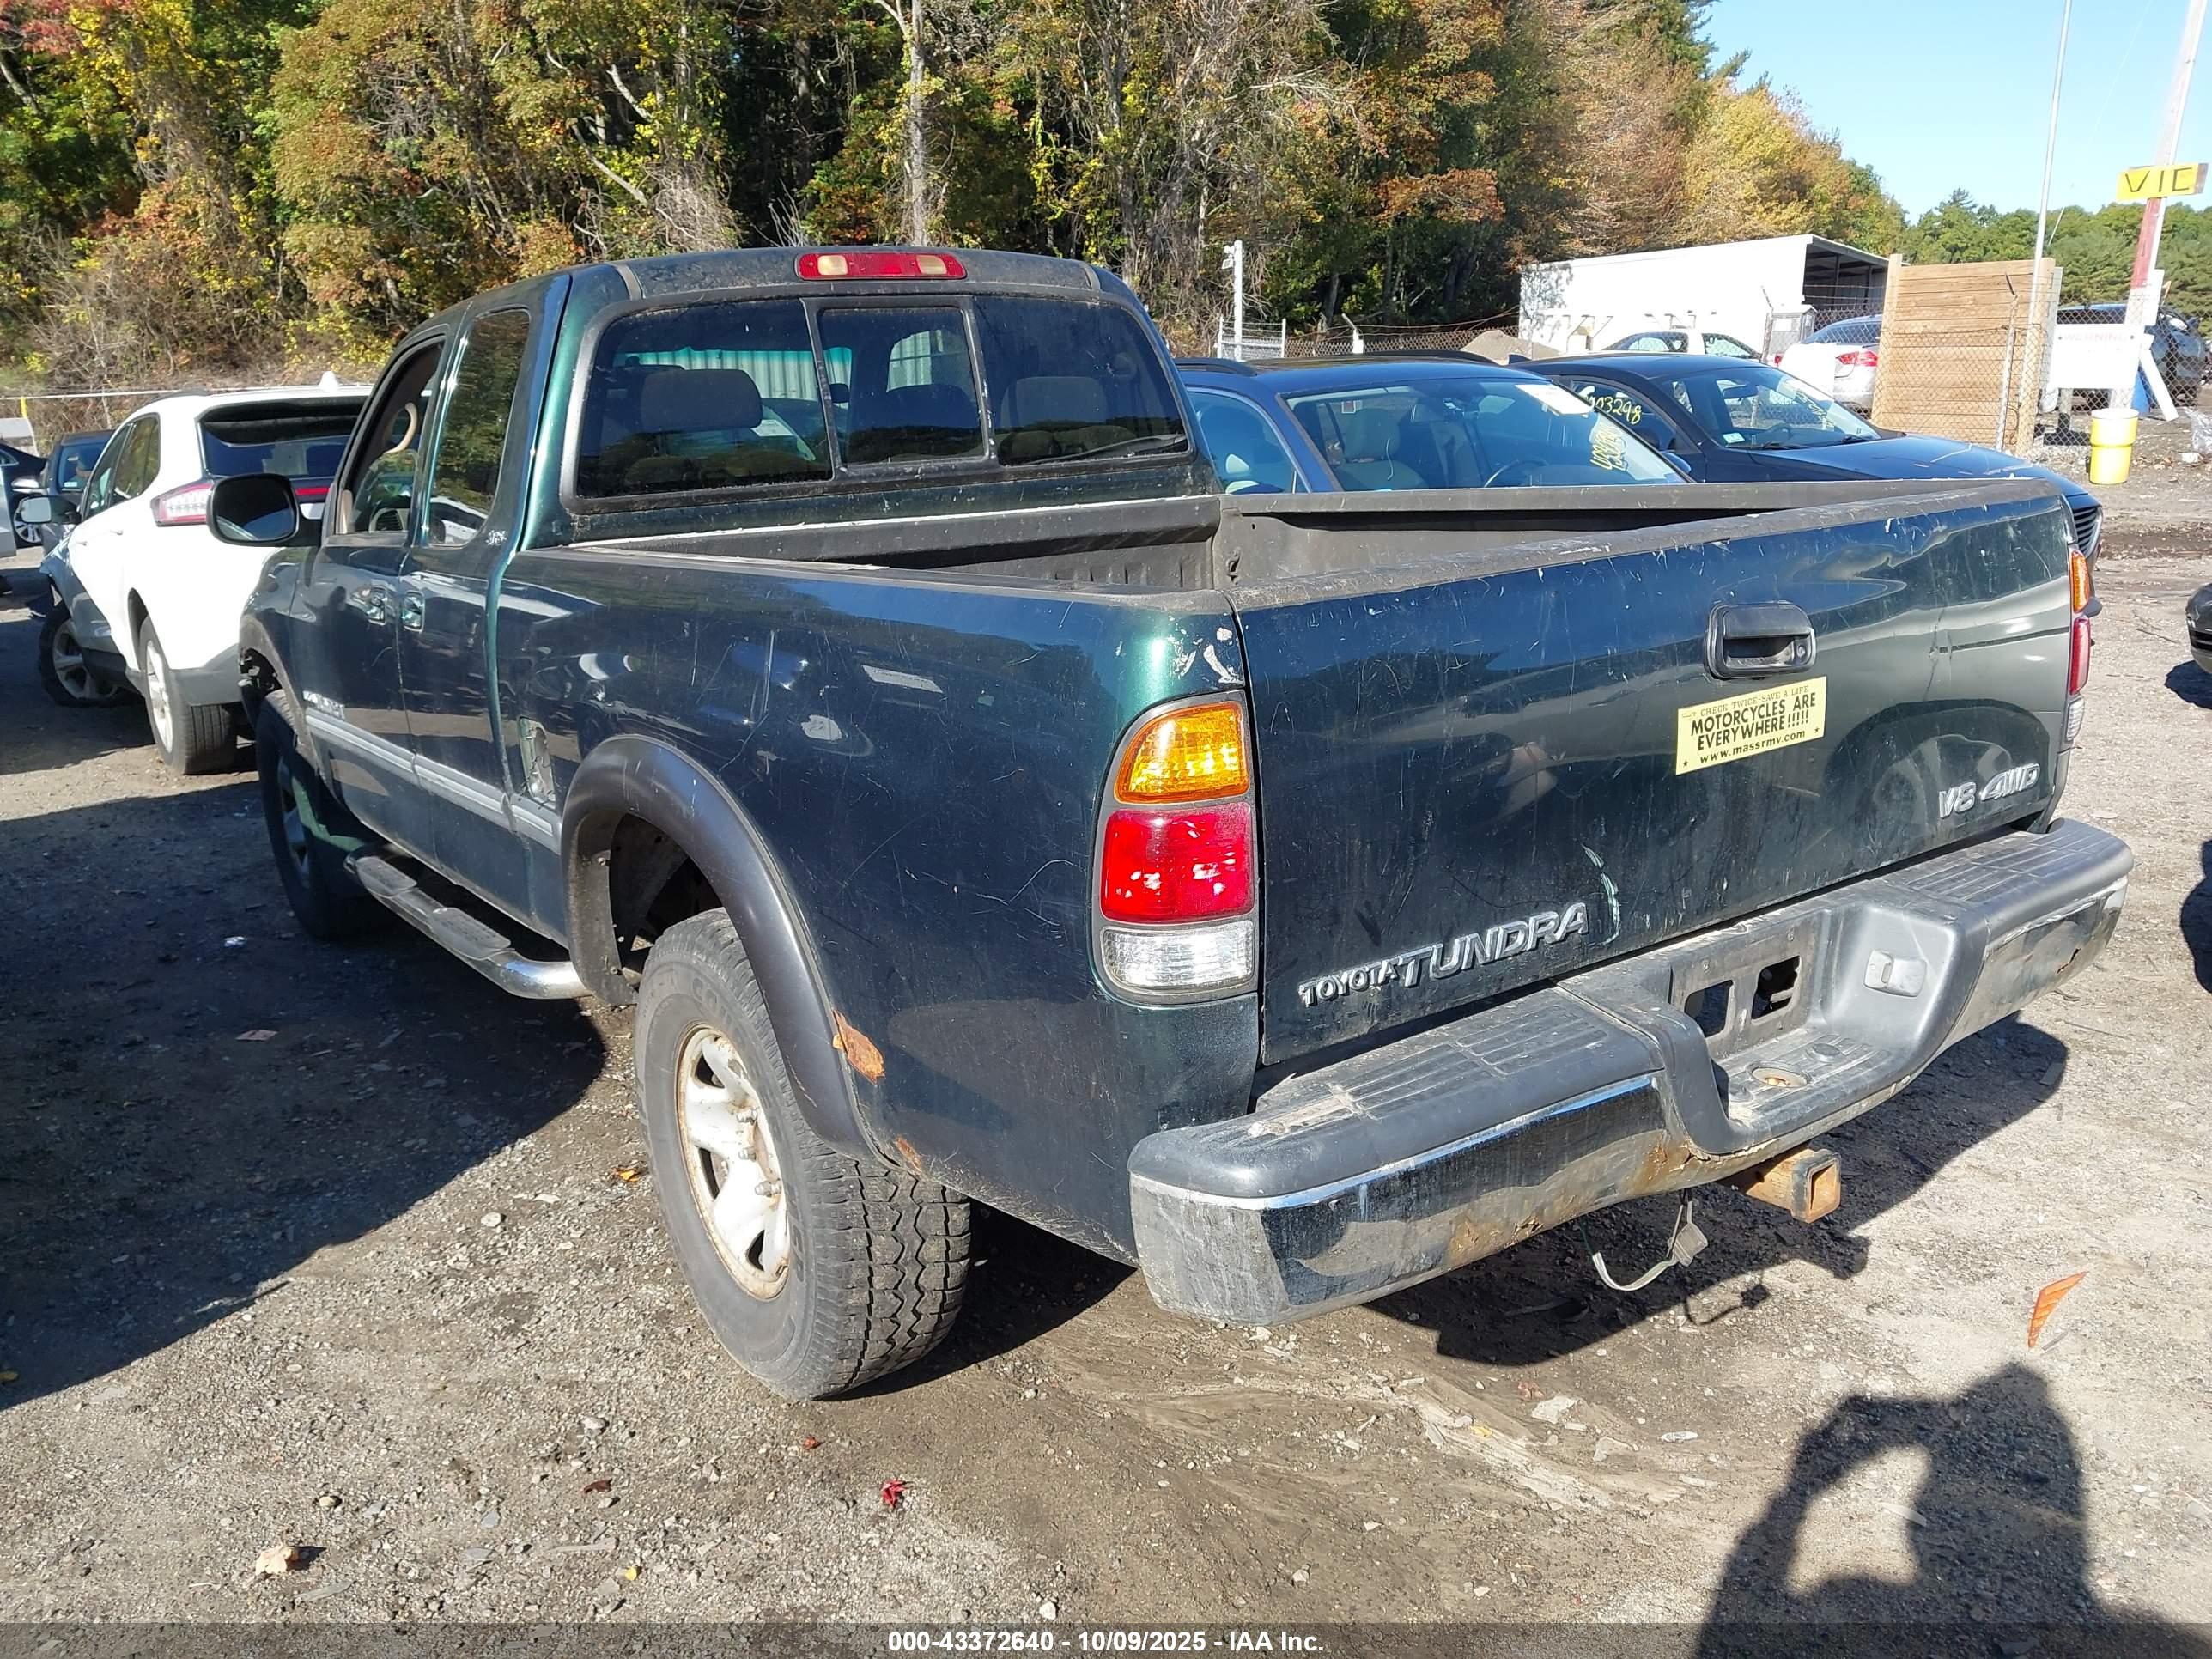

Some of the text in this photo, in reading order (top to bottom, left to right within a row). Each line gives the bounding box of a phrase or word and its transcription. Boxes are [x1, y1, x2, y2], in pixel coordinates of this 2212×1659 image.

[2124, 167, 2192, 193] VIC
[1691, 692, 1816, 736] MOTORCYCLES ARE
[1700, 702, 1728, 716] CHECK
[1791, 685, 1809, 696] LIFE
[1699, 730, 1806, 763] www.massrmv.com
[1938, 762, 2041, 818] V8 4WD
[1298, 902, 1589, 1007] TOYOTA TUNDRA
